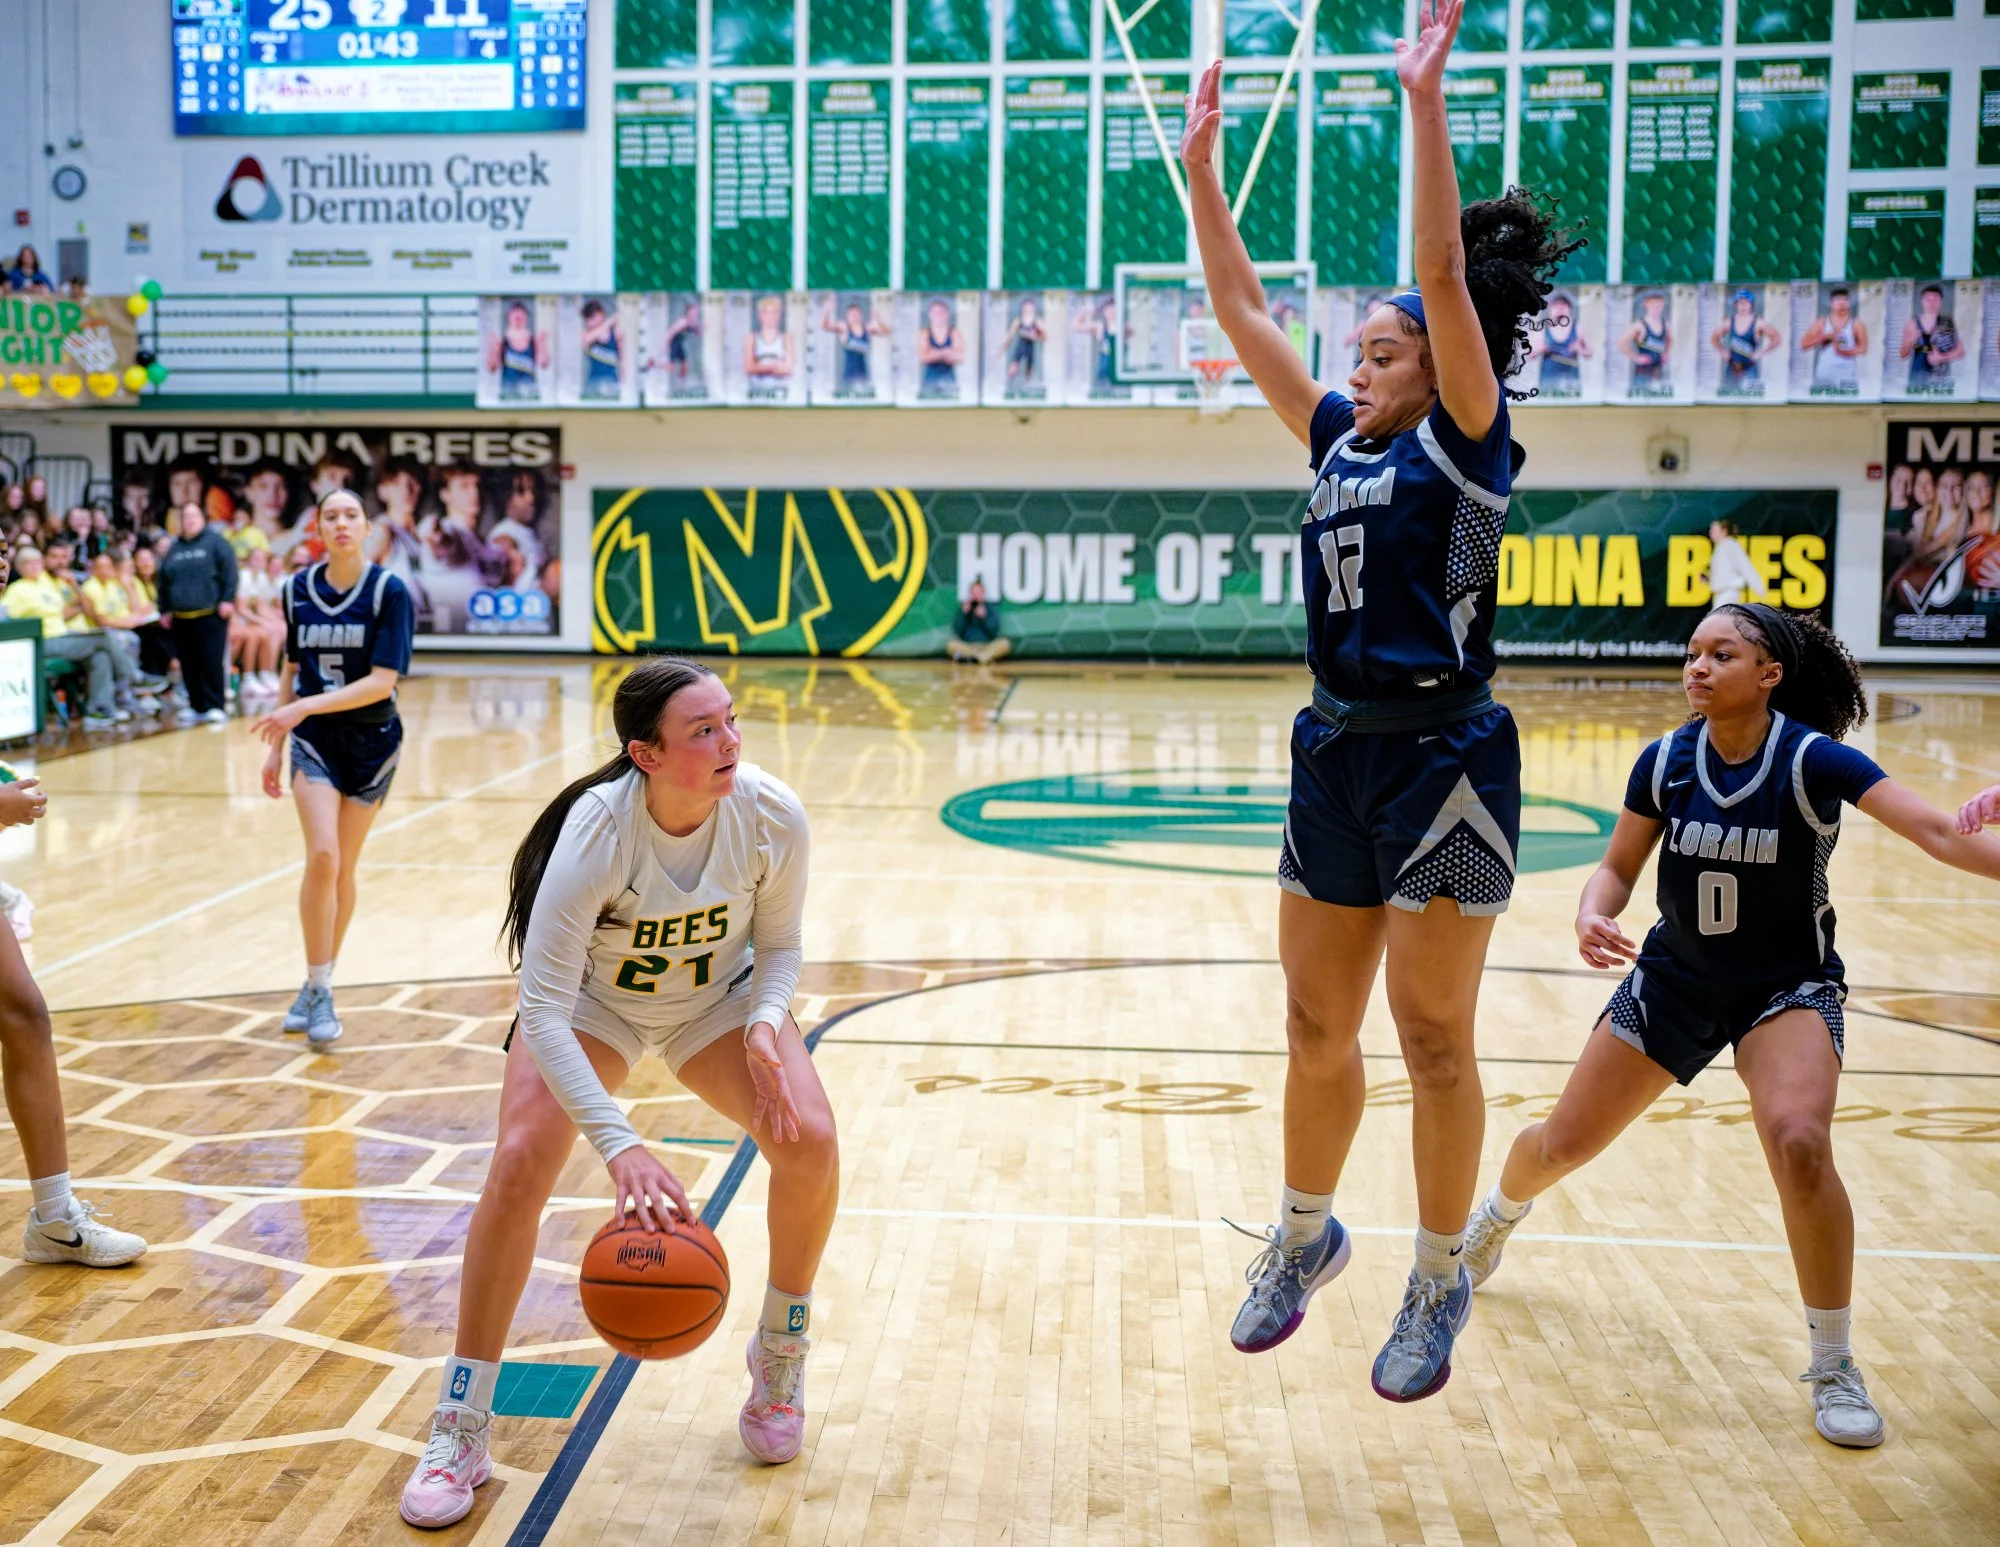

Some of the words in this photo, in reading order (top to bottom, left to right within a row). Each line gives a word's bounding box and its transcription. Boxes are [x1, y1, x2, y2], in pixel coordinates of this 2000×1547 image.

[338, 32, 419, 59] 01:43
[282, 153, 432, 189] Trillium
[445, 151, 551, 188] Creek
[290, 190, 532, 231] Dermatology
[1, 334, 63, 366] GHT
[122, 431, 372, 466] MEDINA
[390, 430, 554, 467] BEES
[957, 531, 1135, 605] HOME
[1155, 531, 1235, 606] OF
[1496, 534, 1645, 607] DINA
[1666, 533, 1827, 609] BES
[1318, 523, 1364, 613] 12
[297, 623, 365, 649] LORAIN
[1493, 639, 1576, 658] Sponsored
[1578, 640, 1599, 659] by
[1601, 640, 1627, 657] the
[1629, 640, 1687, 658] Medina
[318, 652, 346, 693] 5
[1440, 671, 1450, 681] M
[1669, 817, 1779, 864] LORAIN
[1698, 870, 1738, 936] 0
[631, 902, 729, 949] BEES
[614, 951, 717, 995] 21
